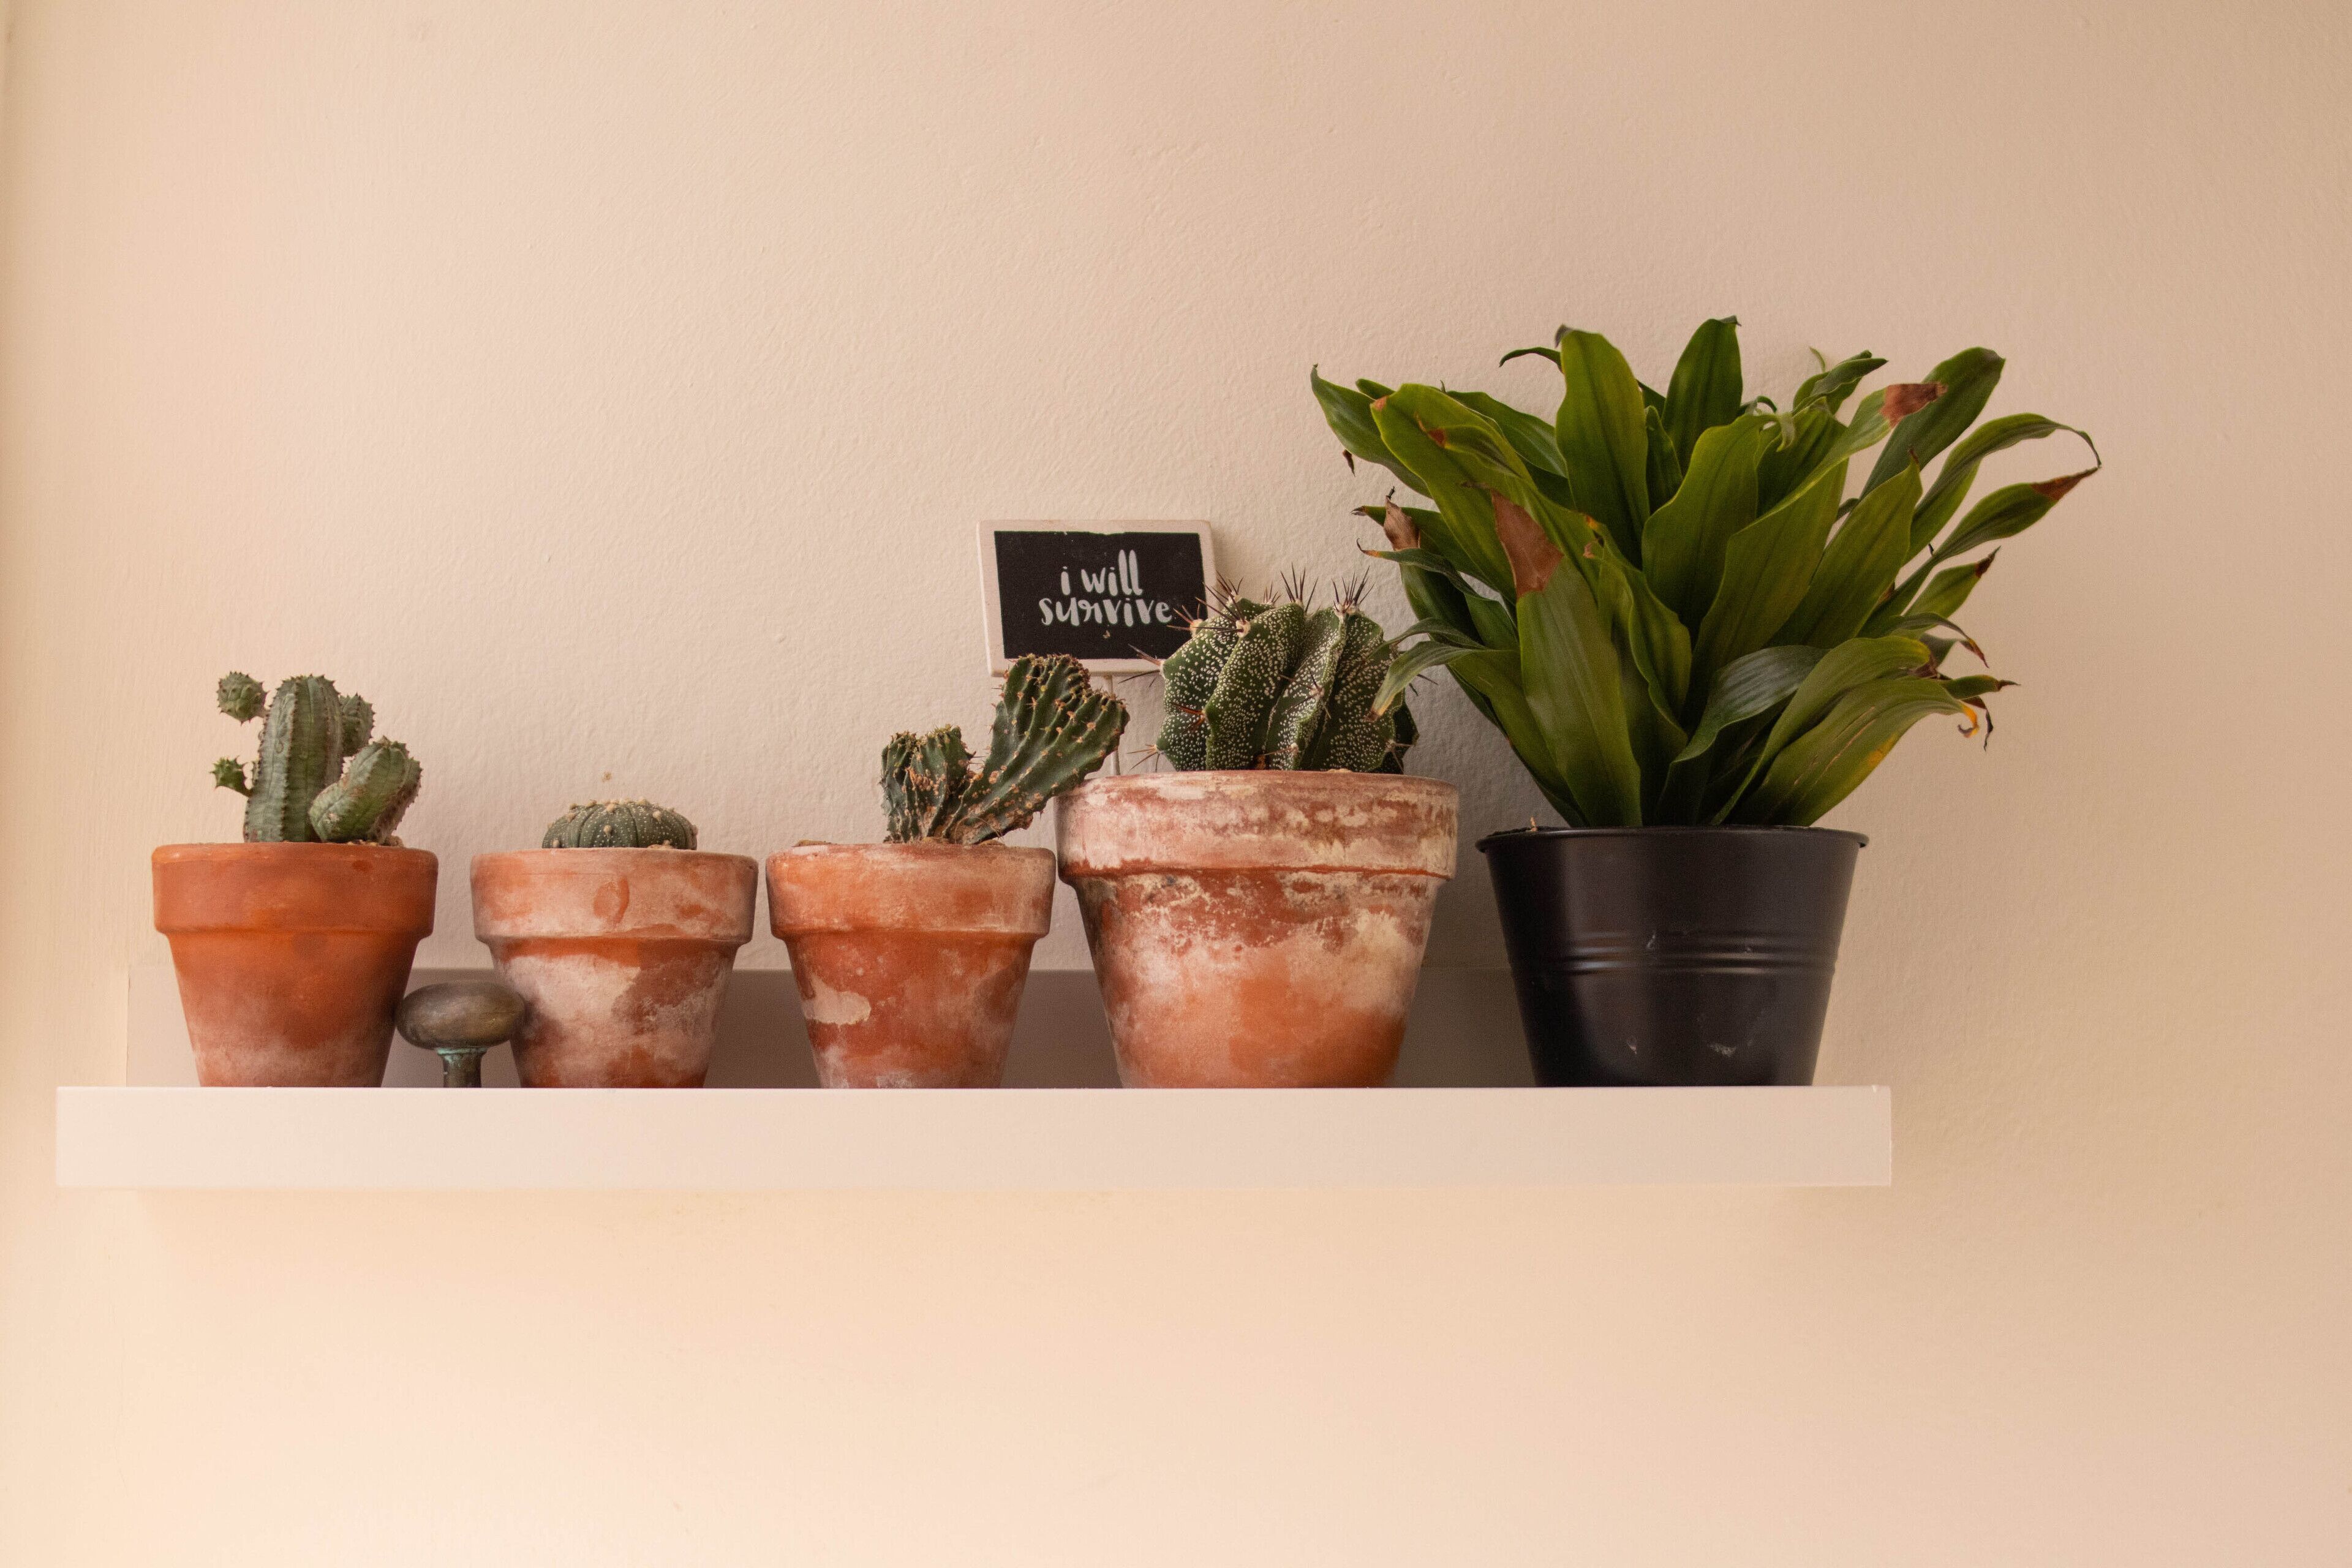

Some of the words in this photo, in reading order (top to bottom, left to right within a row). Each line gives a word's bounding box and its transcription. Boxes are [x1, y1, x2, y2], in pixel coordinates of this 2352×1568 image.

[1060, 566, 1071, 596] i
[1080, 549, 1143, 597] will
[1038, 597, 1172, 627] survive
